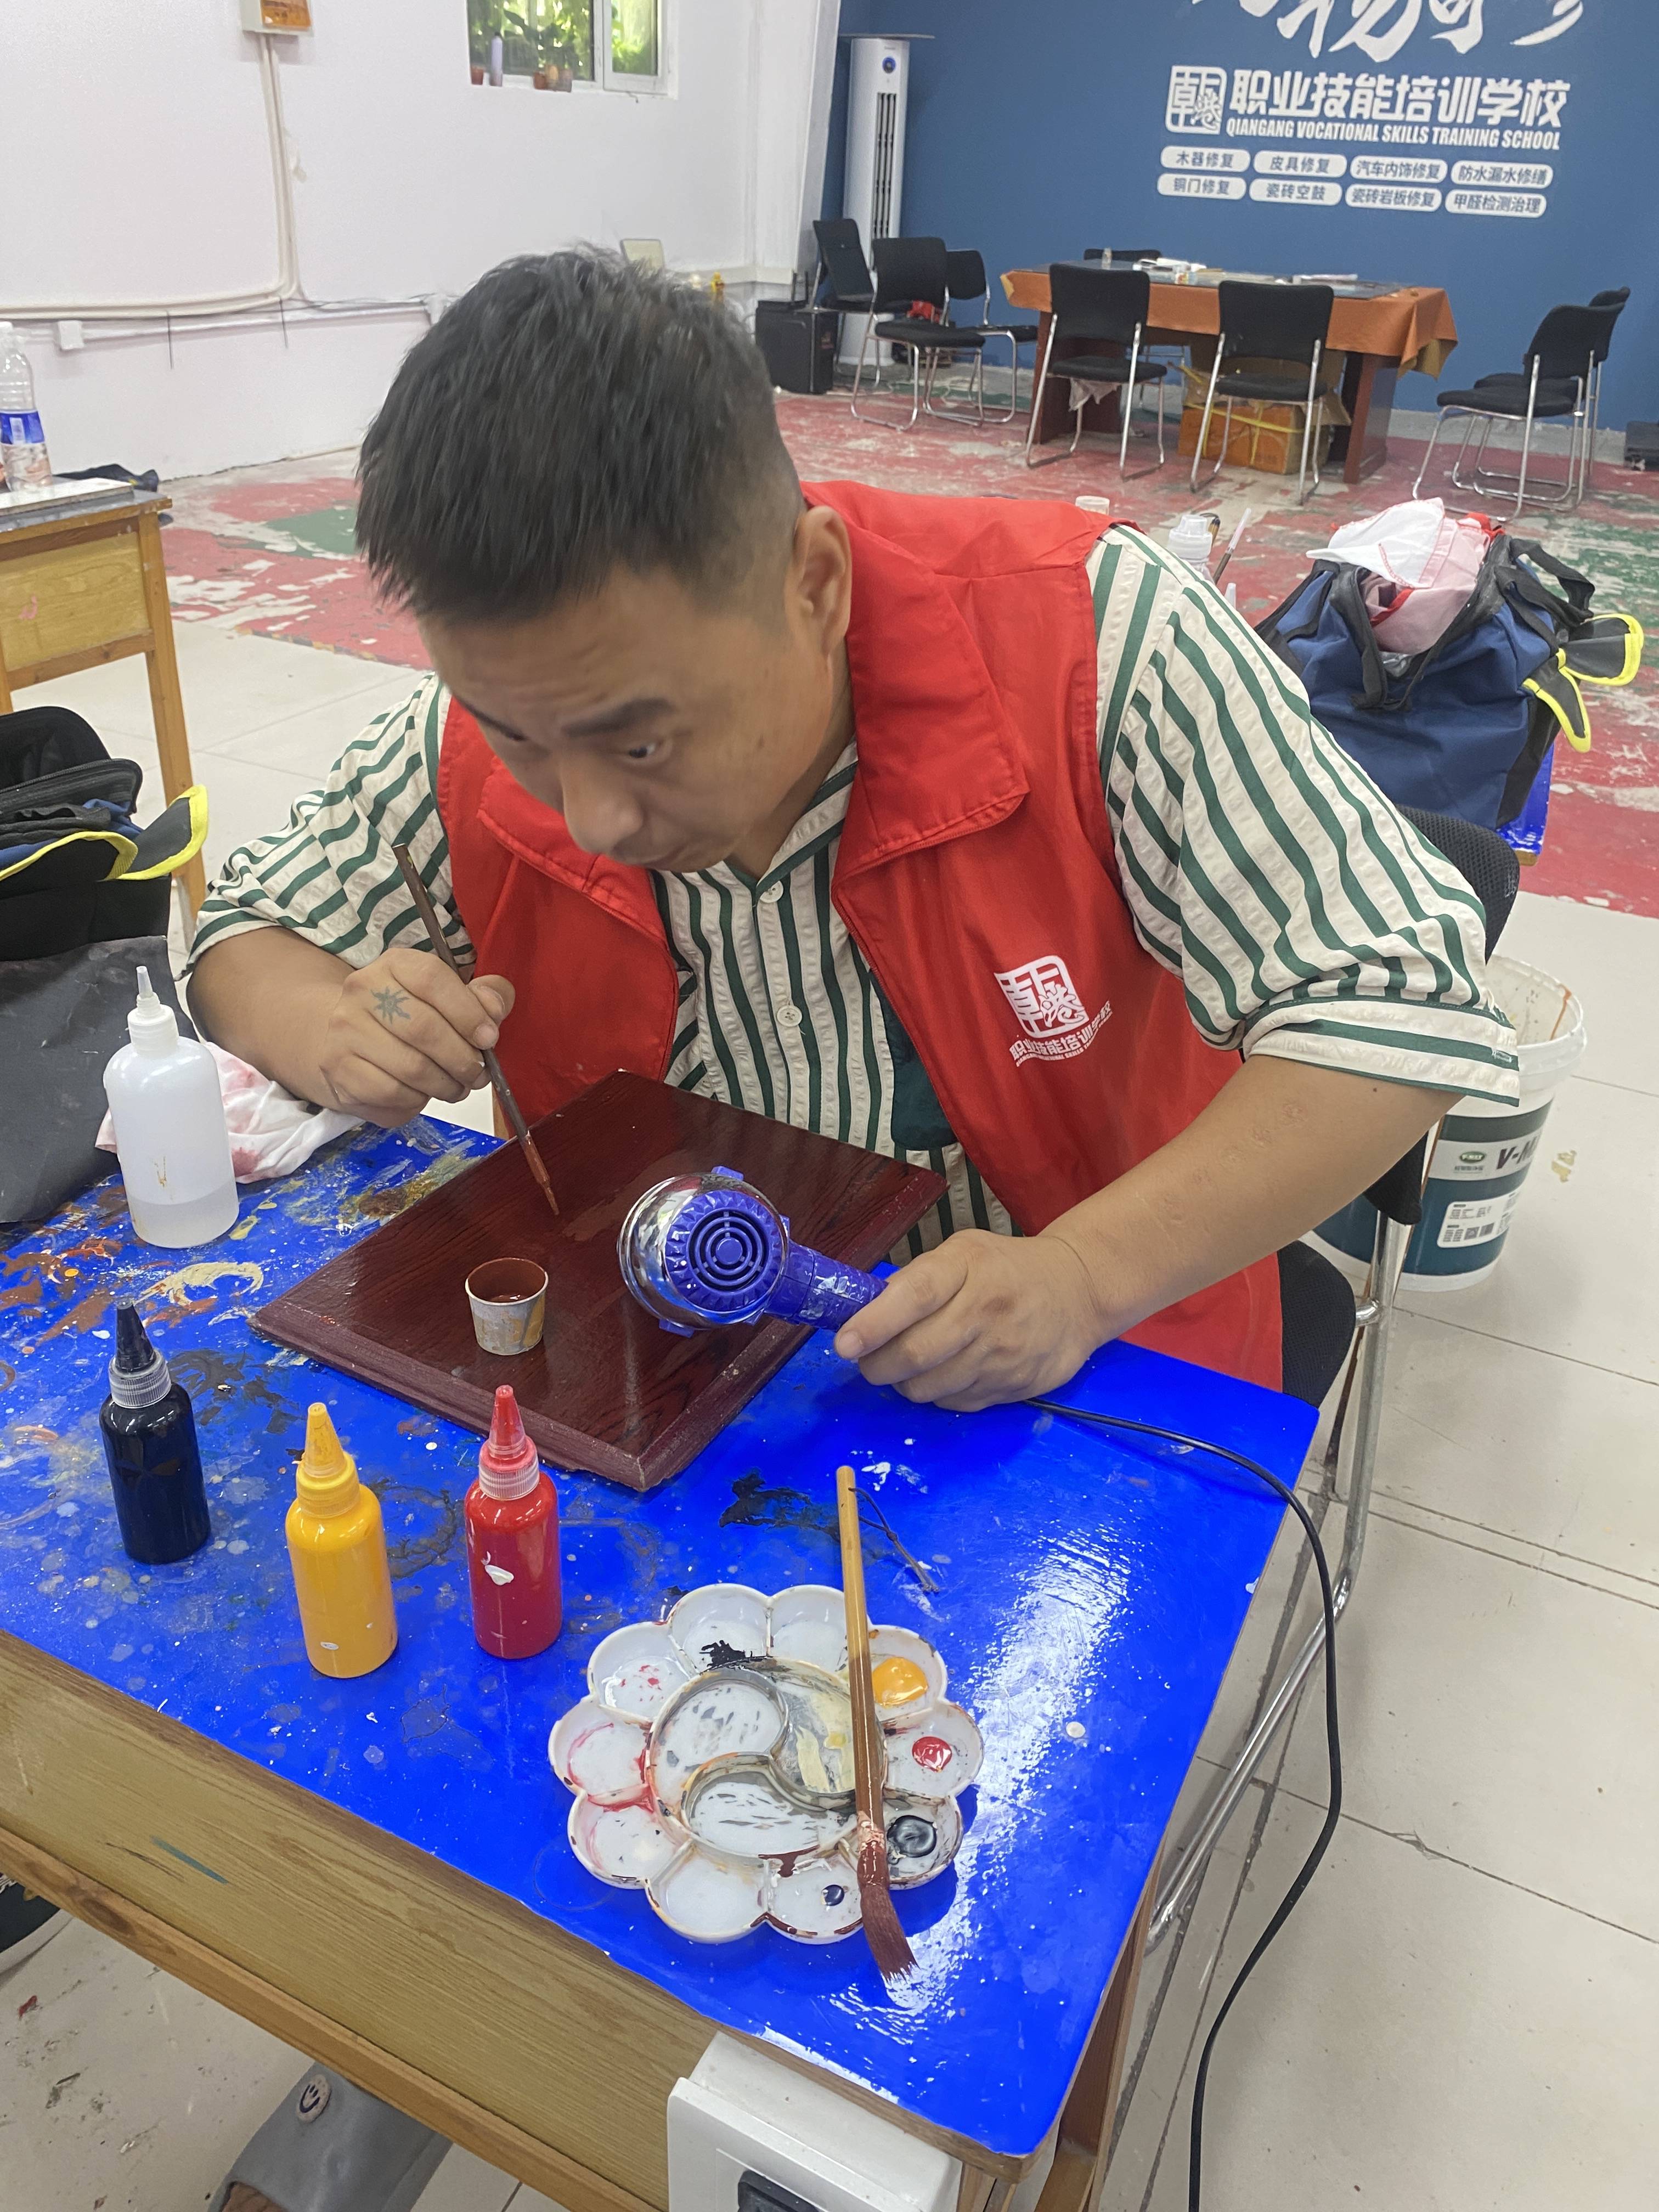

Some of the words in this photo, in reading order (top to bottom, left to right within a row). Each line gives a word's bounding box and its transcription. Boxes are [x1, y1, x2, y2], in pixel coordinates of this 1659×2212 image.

[1229, 69, 1571, 128] 职业技能培训学校
[1226, 118, 1294, 138] QIANGANG
[1296, 120, 1379, 142] VOCATIONAL
[1381, 125, 1429, 144] SKILLS
[1431, 127, 1500, 148] TRAINING
[1502, 129, 1560, 150] SCHOOL
[1176, 150, 1234, 168] 木器修复
[1270, 155, 1330, 174] 皮具修复
[1356, 159, 1441, 180] 汽车内饰修复
[1458, 165, 1547, 185] 防水漏水修缮
[1266, 182, 1326, 201] 瓷砖空鼓
[1352, 188, 1436, 207] 瓷砖岩板修复
[1454, 193, 1542, 213] 甲醛检测治理
